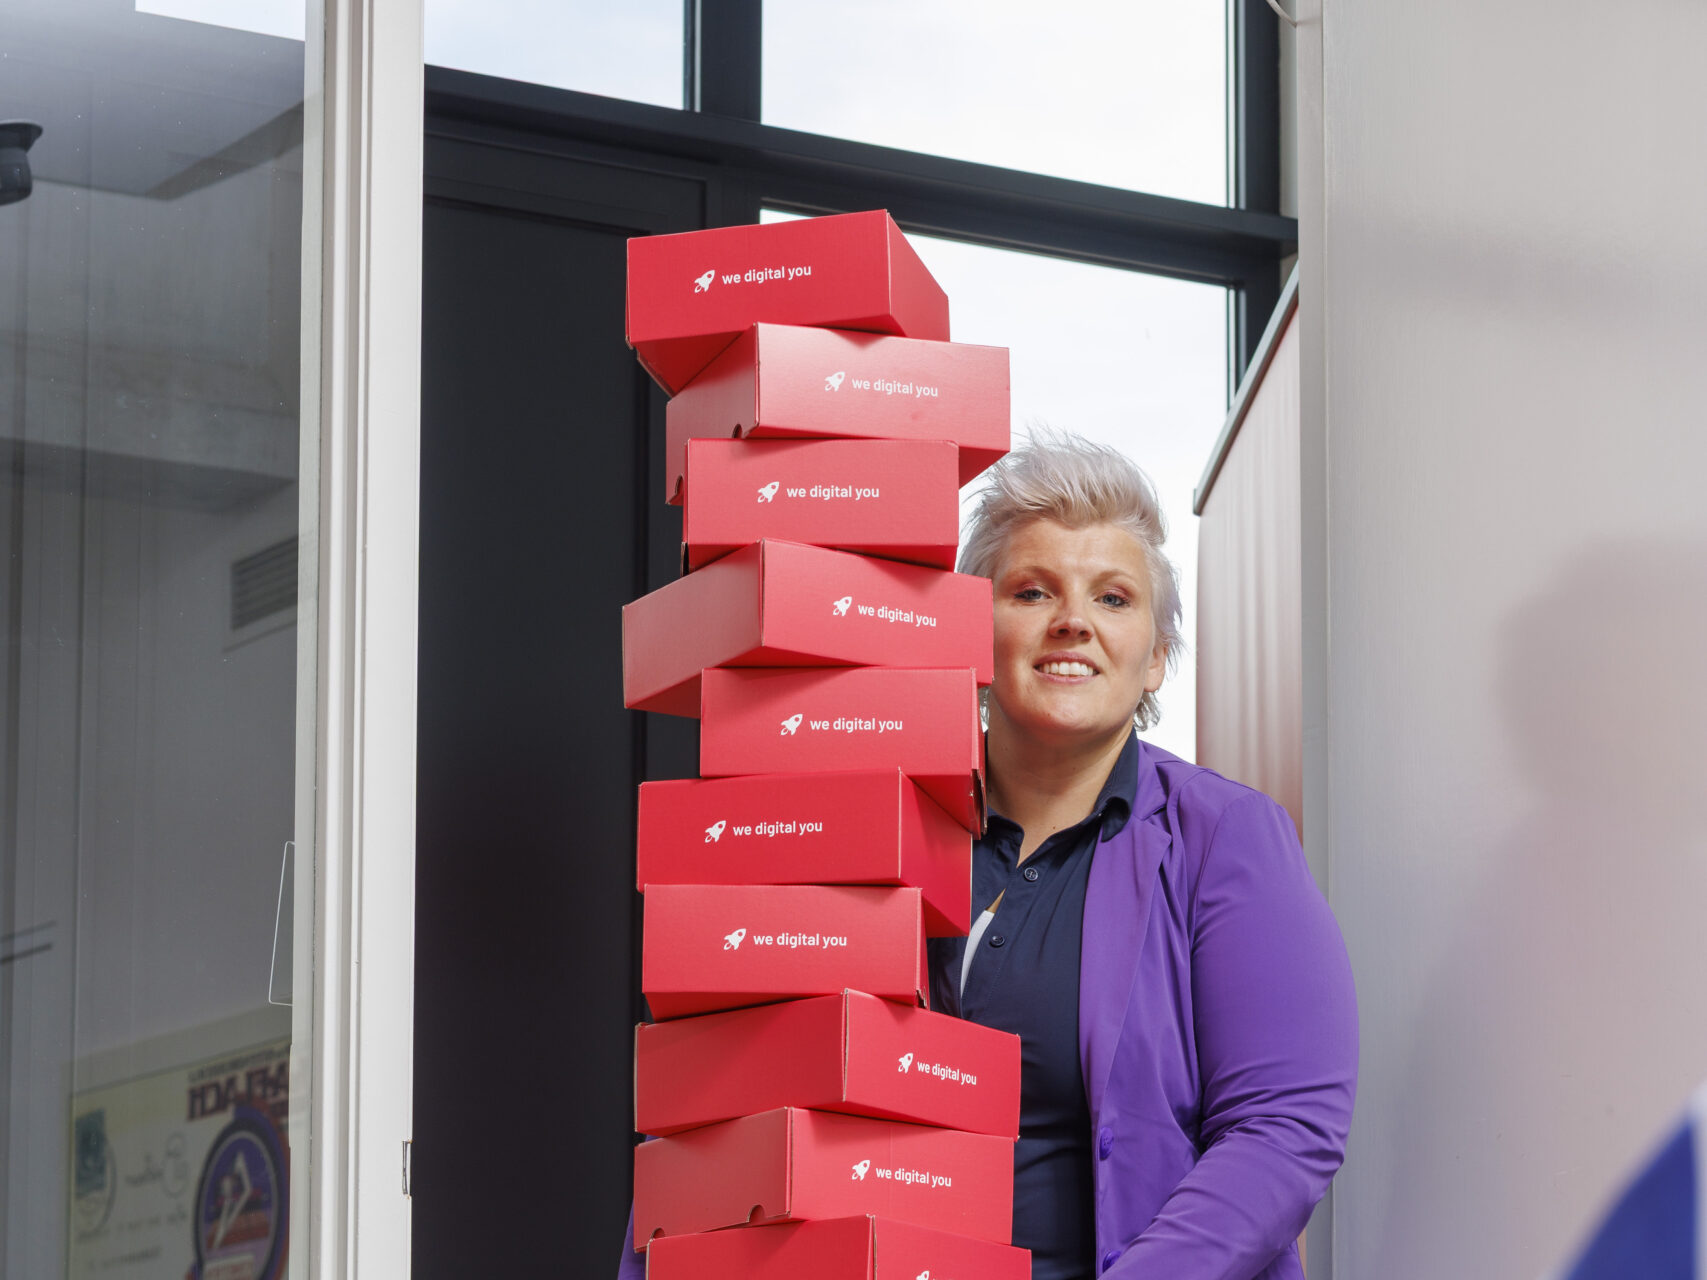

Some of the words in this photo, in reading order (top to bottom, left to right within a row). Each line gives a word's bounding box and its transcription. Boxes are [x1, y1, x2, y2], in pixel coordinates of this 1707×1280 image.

[721, 273, 741, 285] we
[743, 265, 785, 284] digital
[787, 265, 812, 281] you
[851, 378, 871, 390] we
[873, 378, 913, 396] digital
[915, 385, 939, 398] you
[786, 487, 807, 498] we
[809, 484, 852, 501] digital
[855, 487, 880, 501] you
[857, 604, 875, 617] we
[877, 605, 914, 624] digital
[915, 614, 937, 628] you
[809, 720, 830, 731] we
[832, 717, 876, 734] digital
[878, 720, 903, 734] you
[732, 825, 752, 836] we
[754, 820, 796, 838] digital
[798, 822, 823, 836] you
[753, 935, 774, 946] we
[776, 932, 820, 949] digital
[822, 936, 847, 949] you
[916, 1061, 931, 1074] we
[931, 1063, 960, 1081] digital
[960, 1072, 977, 1086] you
[875, 1167, 893, 1180] we
[894, 1167, 930, 1186] digital
[931, 1175, 952, 1188] you
